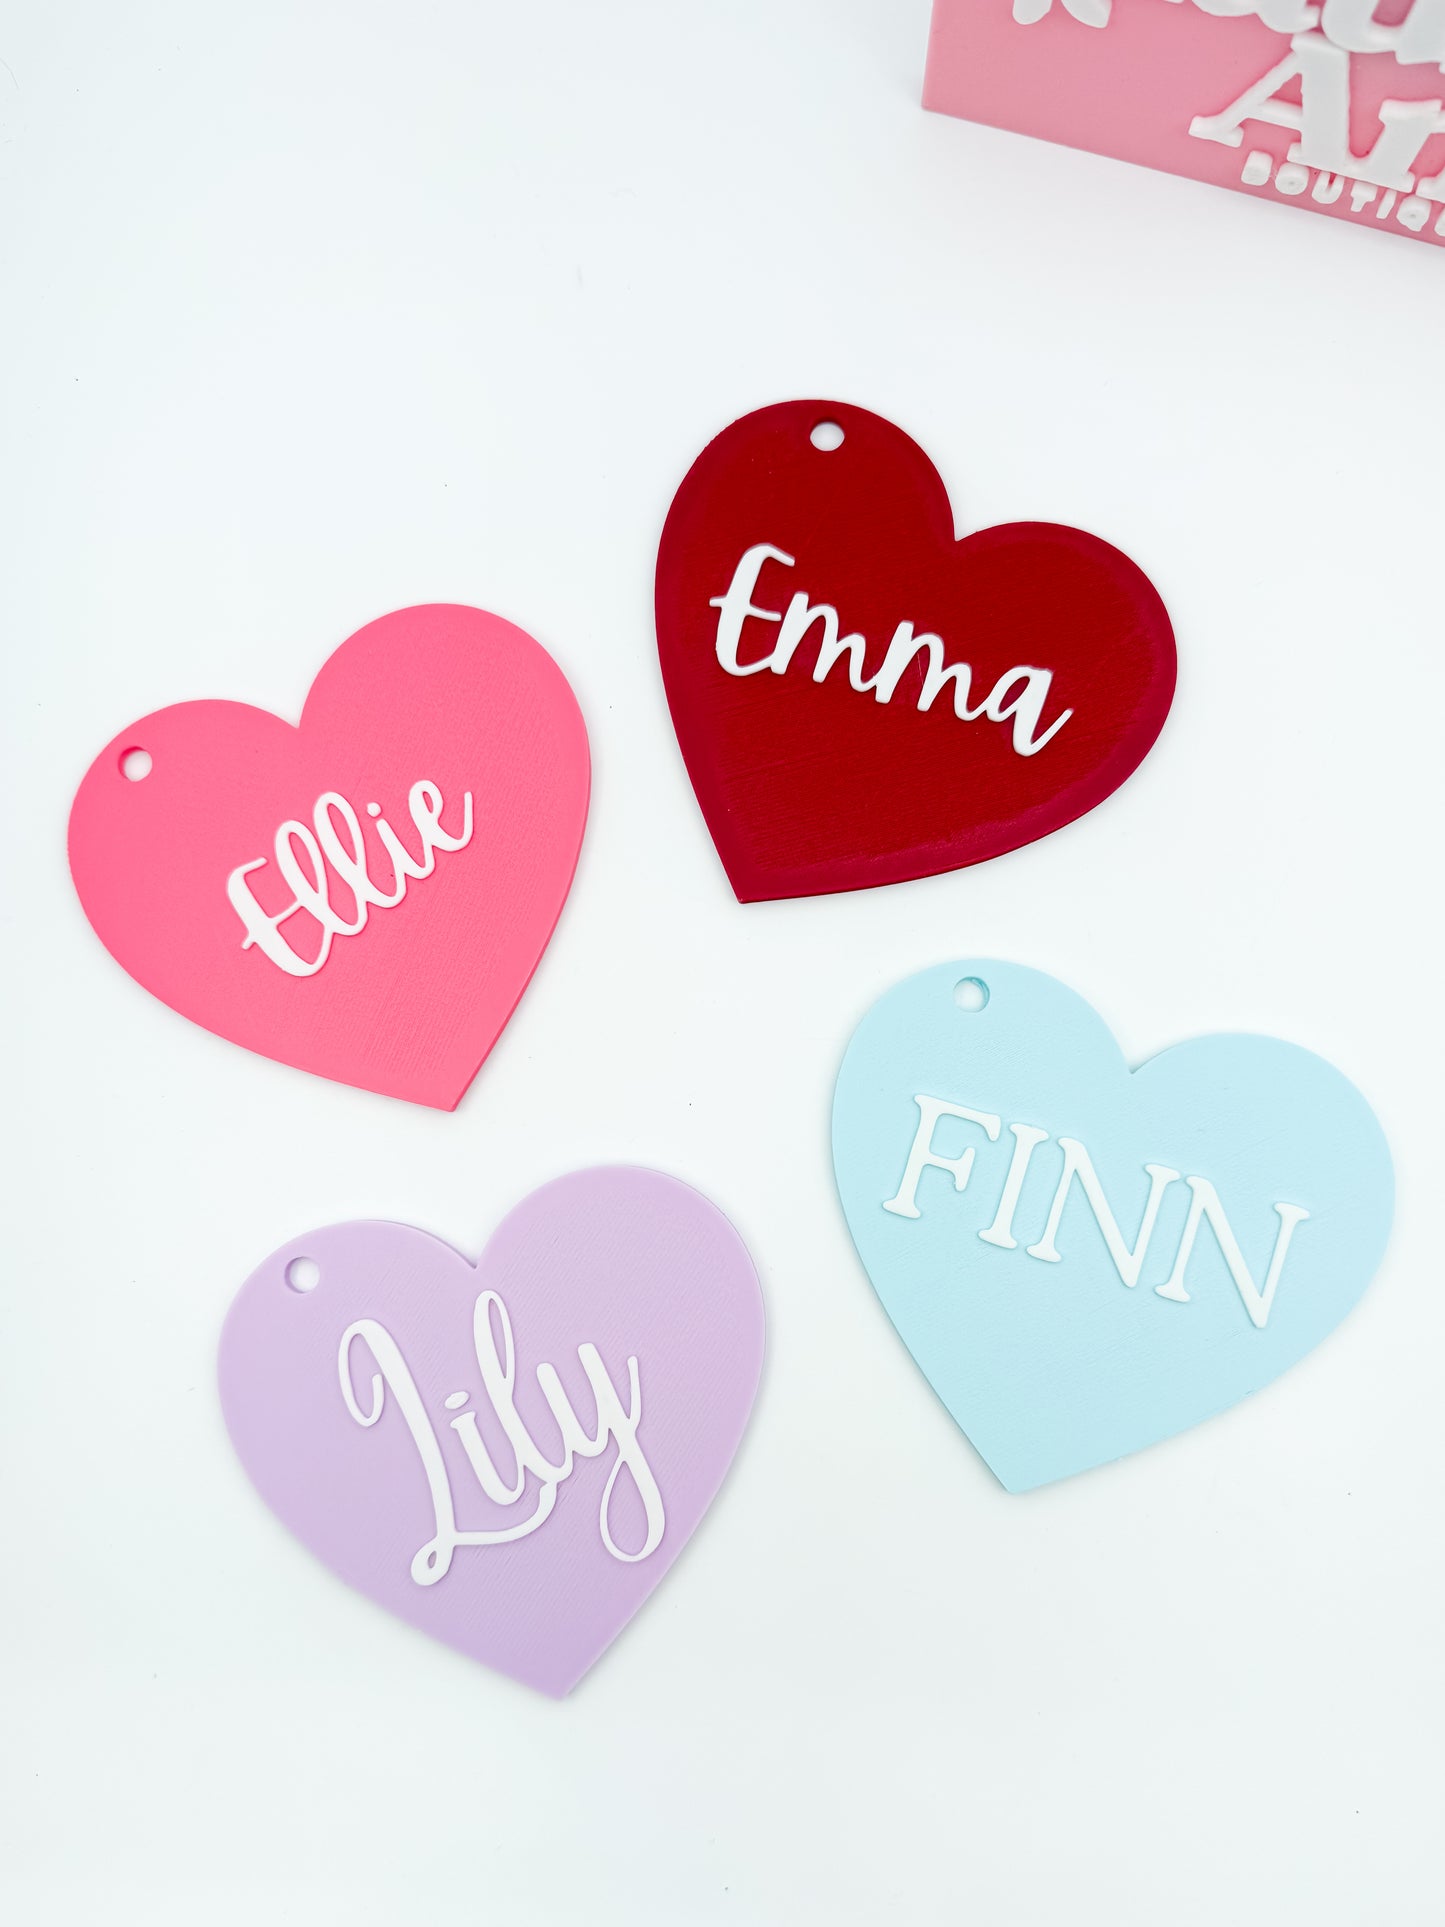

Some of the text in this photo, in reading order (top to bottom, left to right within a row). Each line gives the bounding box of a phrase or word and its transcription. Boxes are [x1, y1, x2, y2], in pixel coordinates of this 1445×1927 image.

[1240, 150, 1445, 236] BOUTIQ
[709, 542, 1074, 757] Emma
[226, 780, 474, 977] Ellie
[882, 1094, 1311, 1329] FINN
[338, 1289, 666, 1587] Lily
